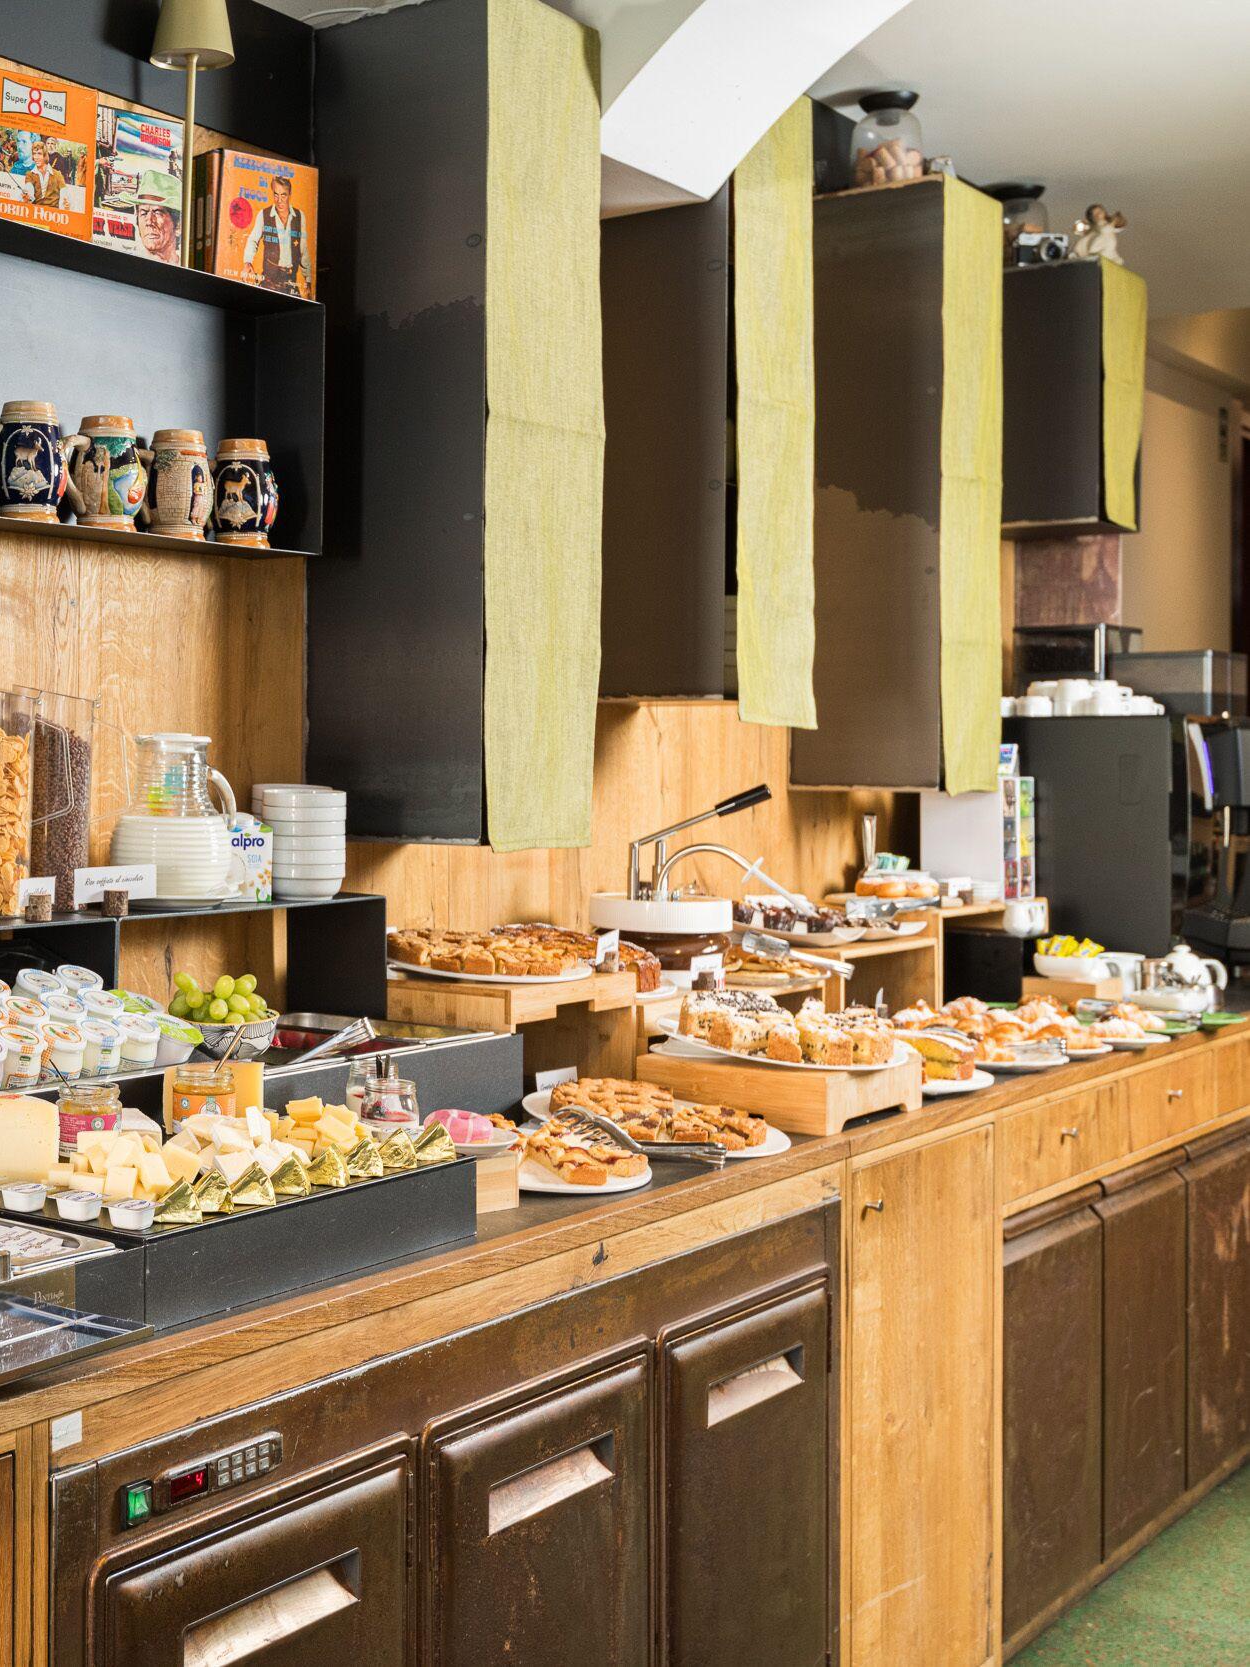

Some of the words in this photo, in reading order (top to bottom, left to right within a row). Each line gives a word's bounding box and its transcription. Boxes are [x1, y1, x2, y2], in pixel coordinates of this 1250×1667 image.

[5, 91, 27, 104] Super
[28, 87, 42, 117] 8
[43, 100, 63, 113] Rama
[140, 123, 171, 138] CHARLES
[231, 833, 265, 851] alpro
[247, 854, 262, 864] SOIA
